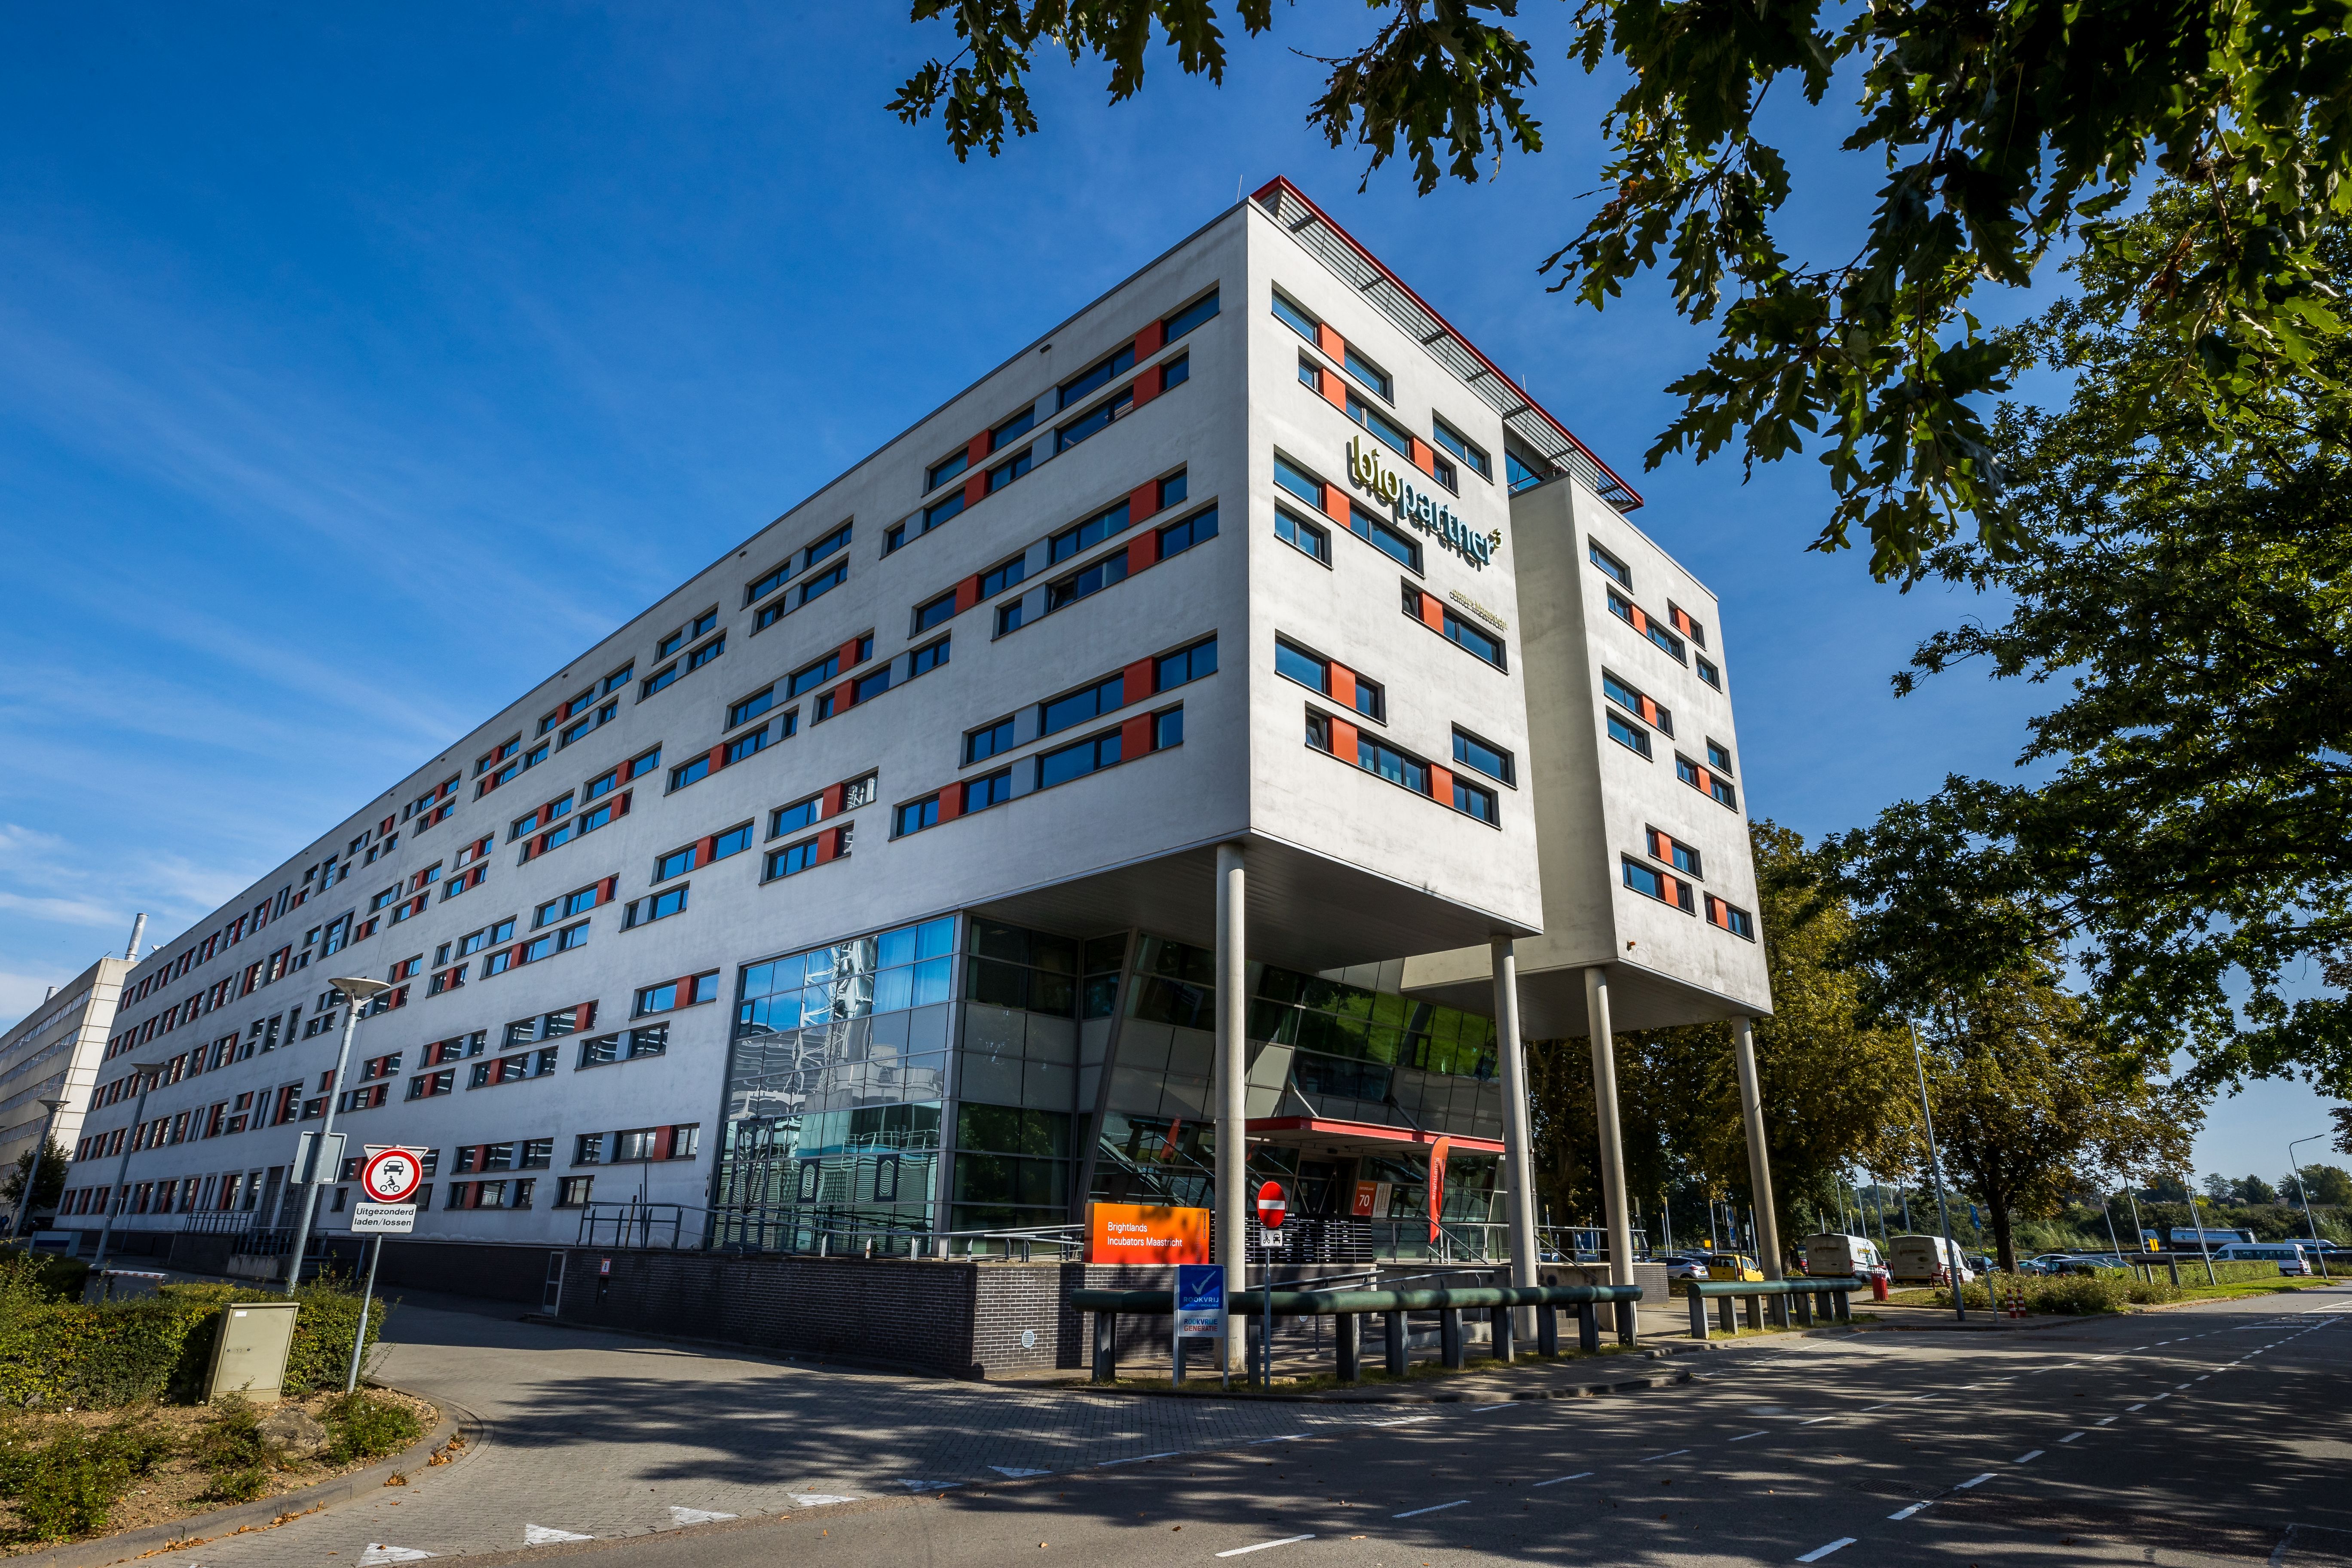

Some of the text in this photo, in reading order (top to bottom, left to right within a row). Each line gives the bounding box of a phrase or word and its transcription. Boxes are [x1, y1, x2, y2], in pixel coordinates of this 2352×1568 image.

[1359, 1194, 1370, 1207] 70
[356, 1208, 414, 1216] Uitgezonderd
[1108, 1222, 1147, 1233] Brightlands
[1108, 1236, 1182, 1246] Incubators Maastricht
